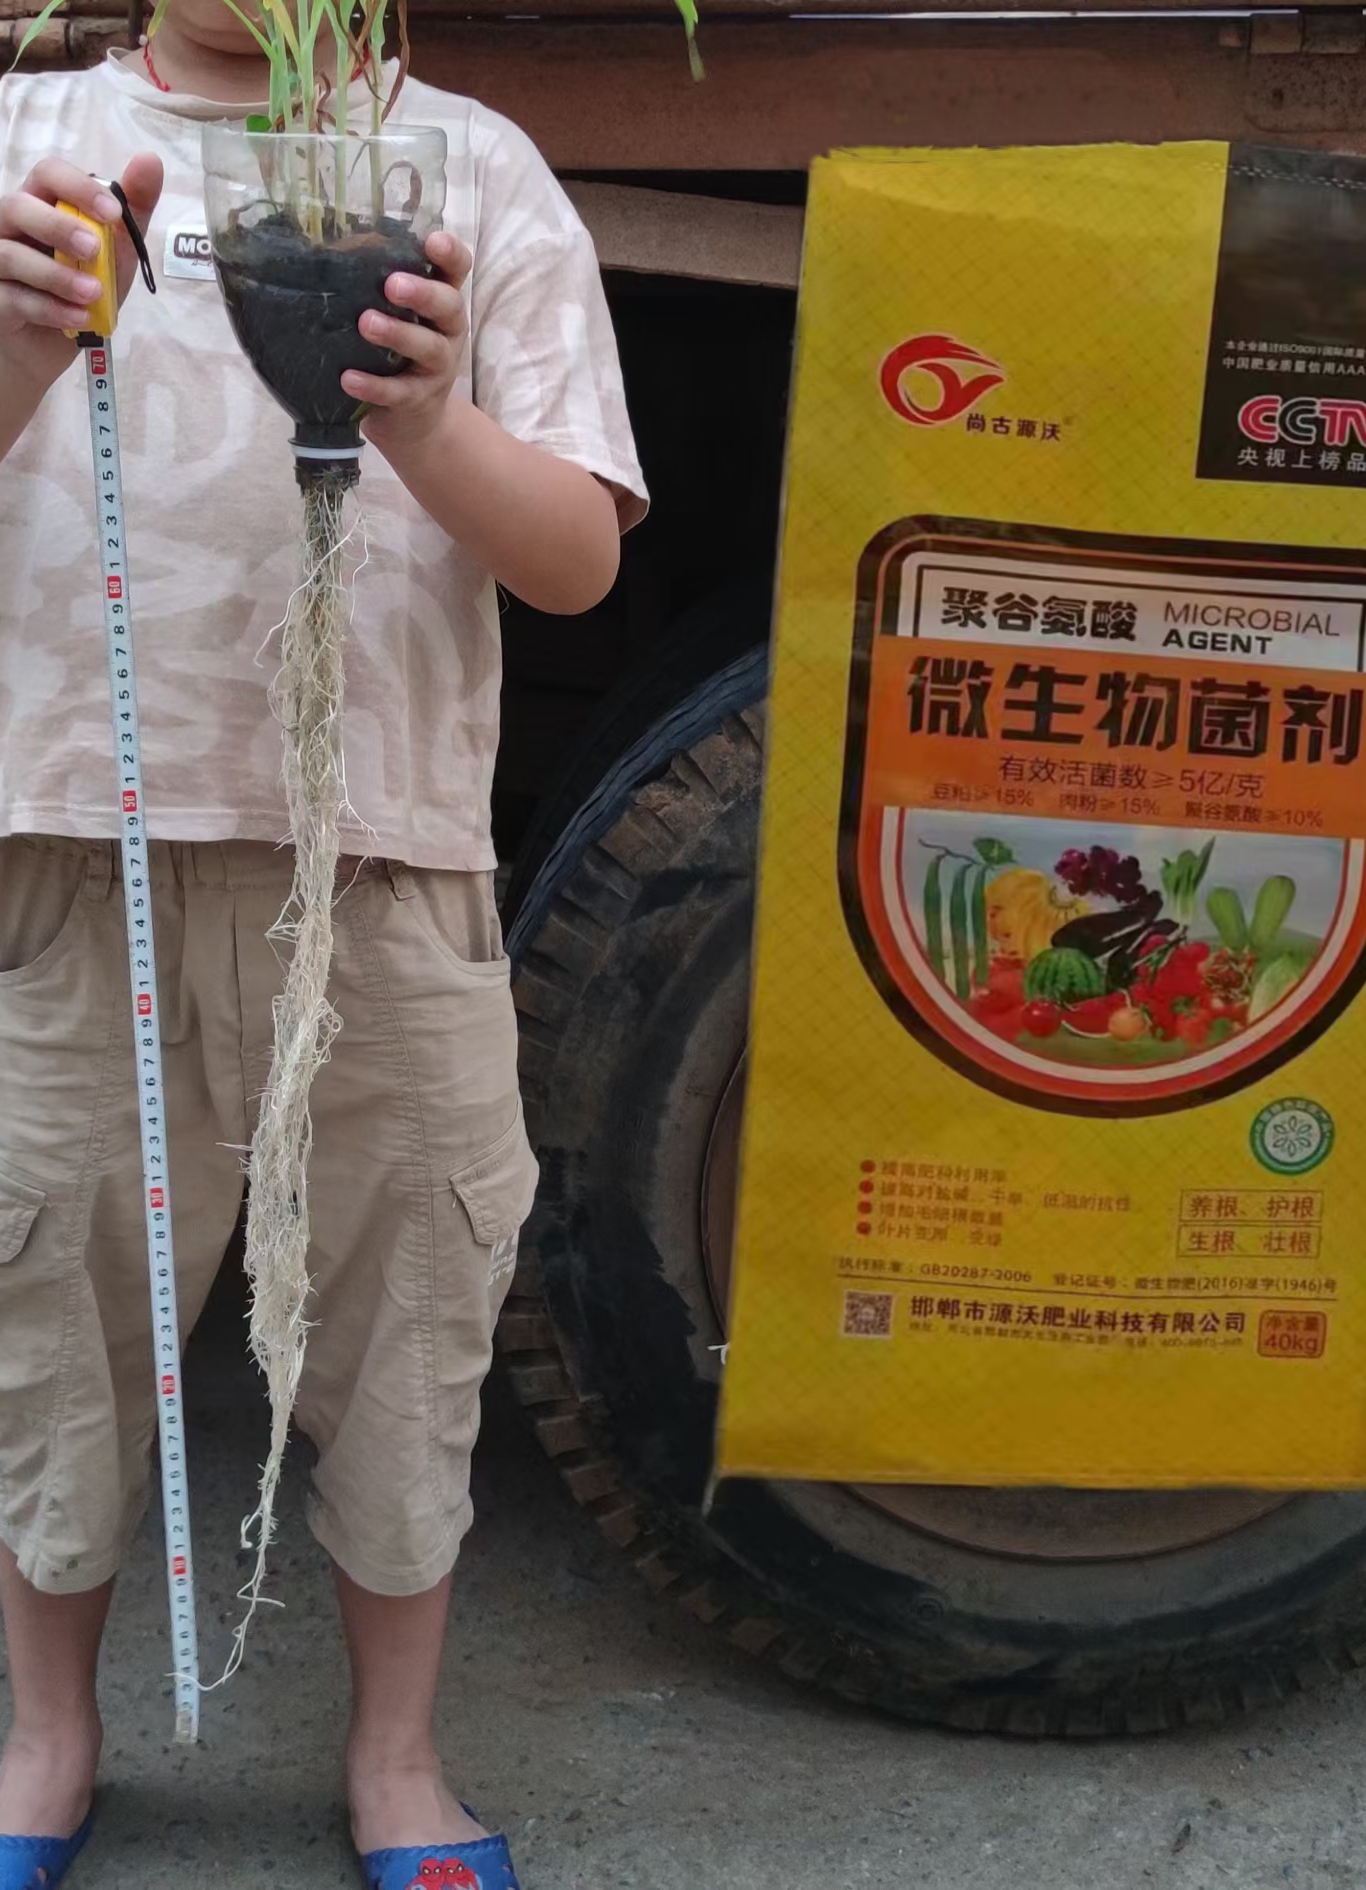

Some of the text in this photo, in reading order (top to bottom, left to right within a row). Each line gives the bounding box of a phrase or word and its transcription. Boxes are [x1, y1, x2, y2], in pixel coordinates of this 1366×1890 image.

[965, 412, 1062, 442] 尚古源沃
[940, 585, 1139, 642] 聚谷氨酸
[1162, 600, 1341, 637] MICROBIAL
[1161, 628, 1273, 655] AGENT
[906, 655, 1365, 767] 微生物菌剂
[910, 1295, 1247, 1334] 邯郸市源沃肥业科技有限公司
[1264, 1333, 1319, 1355] 40kg
